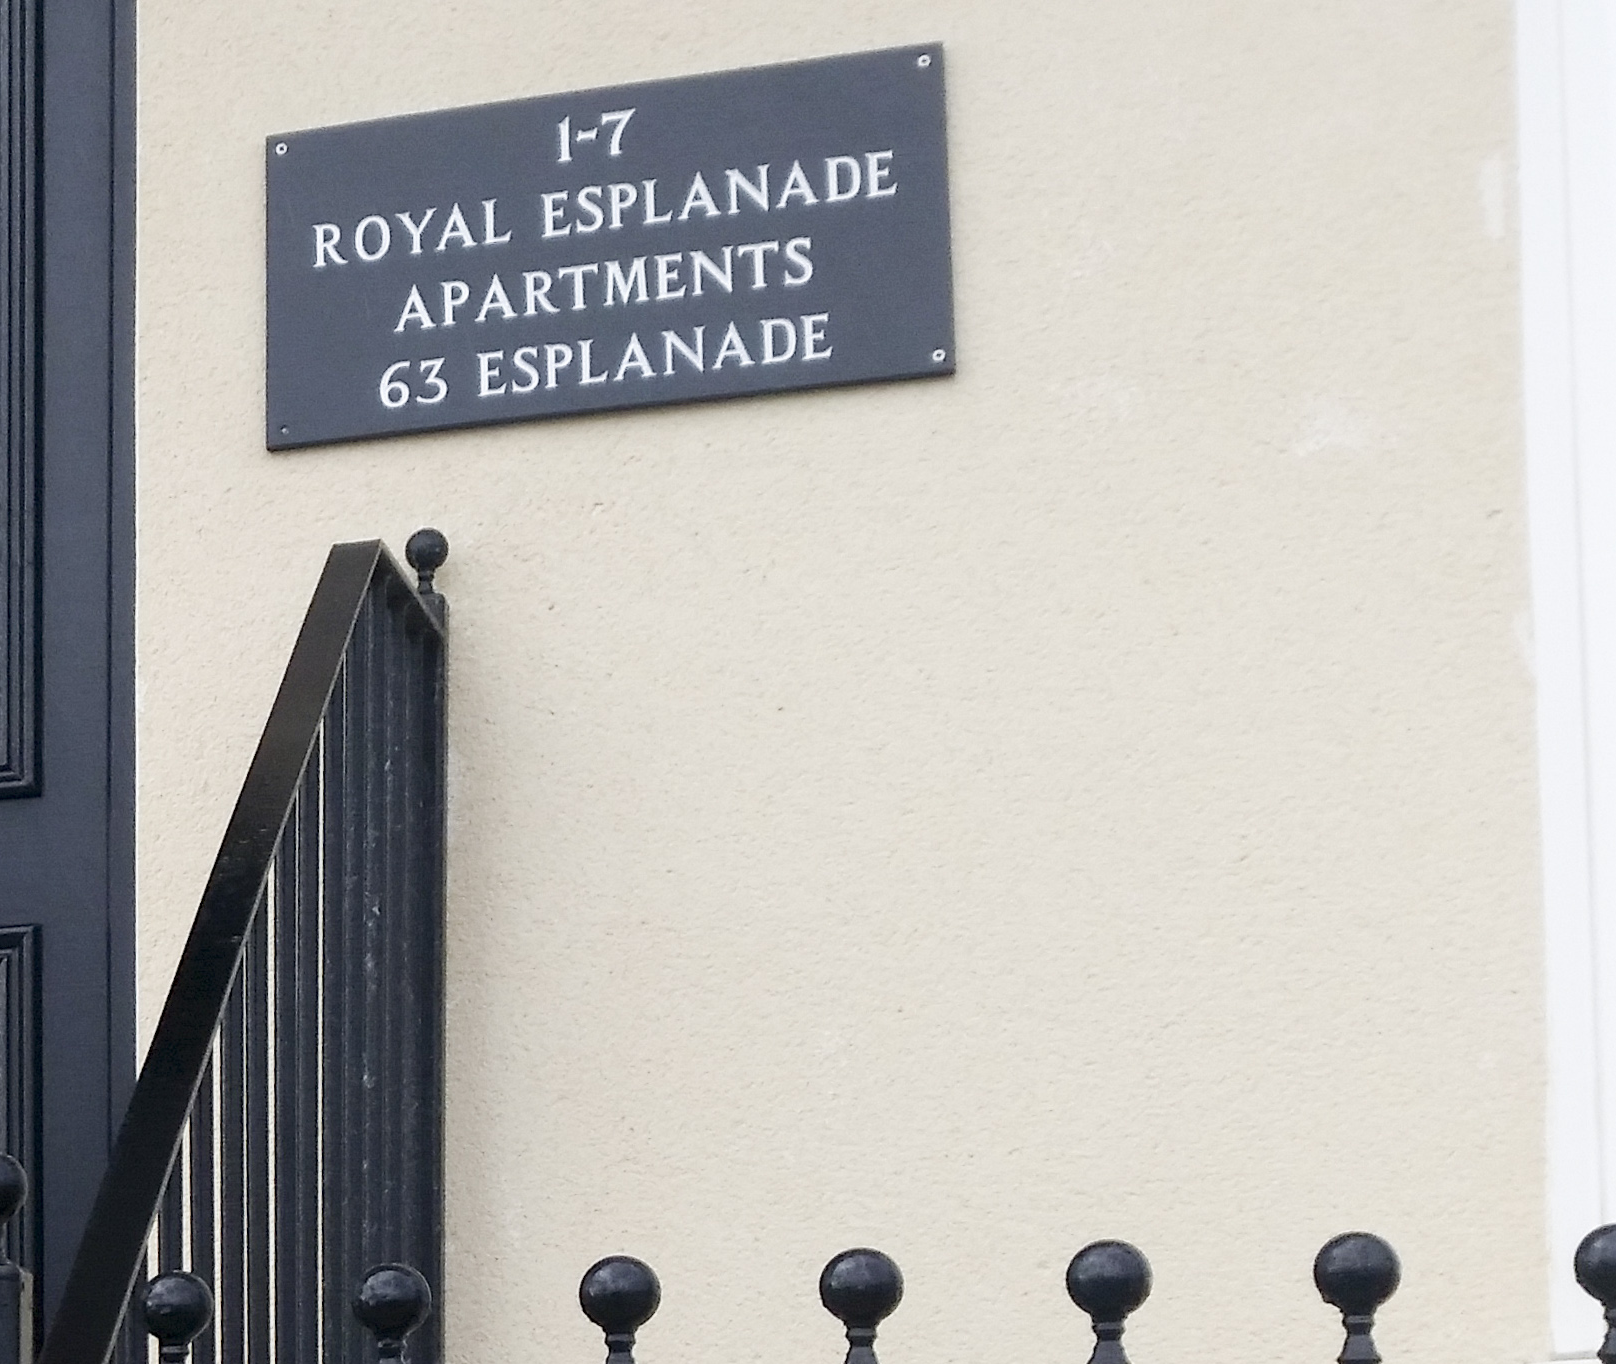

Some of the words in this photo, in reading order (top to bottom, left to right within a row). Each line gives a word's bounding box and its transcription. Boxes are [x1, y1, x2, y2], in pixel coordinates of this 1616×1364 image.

[557, 107, 636, 164] 1-7
[312, 199, 512, 268] ROYAL
[540, 150, 898, 240] ESPLANADE
[393, 237, 814, 333] APARTMENTS
[378, 358, 448, 410] 63
[476, 313, 833, 398] ESPLANADE
